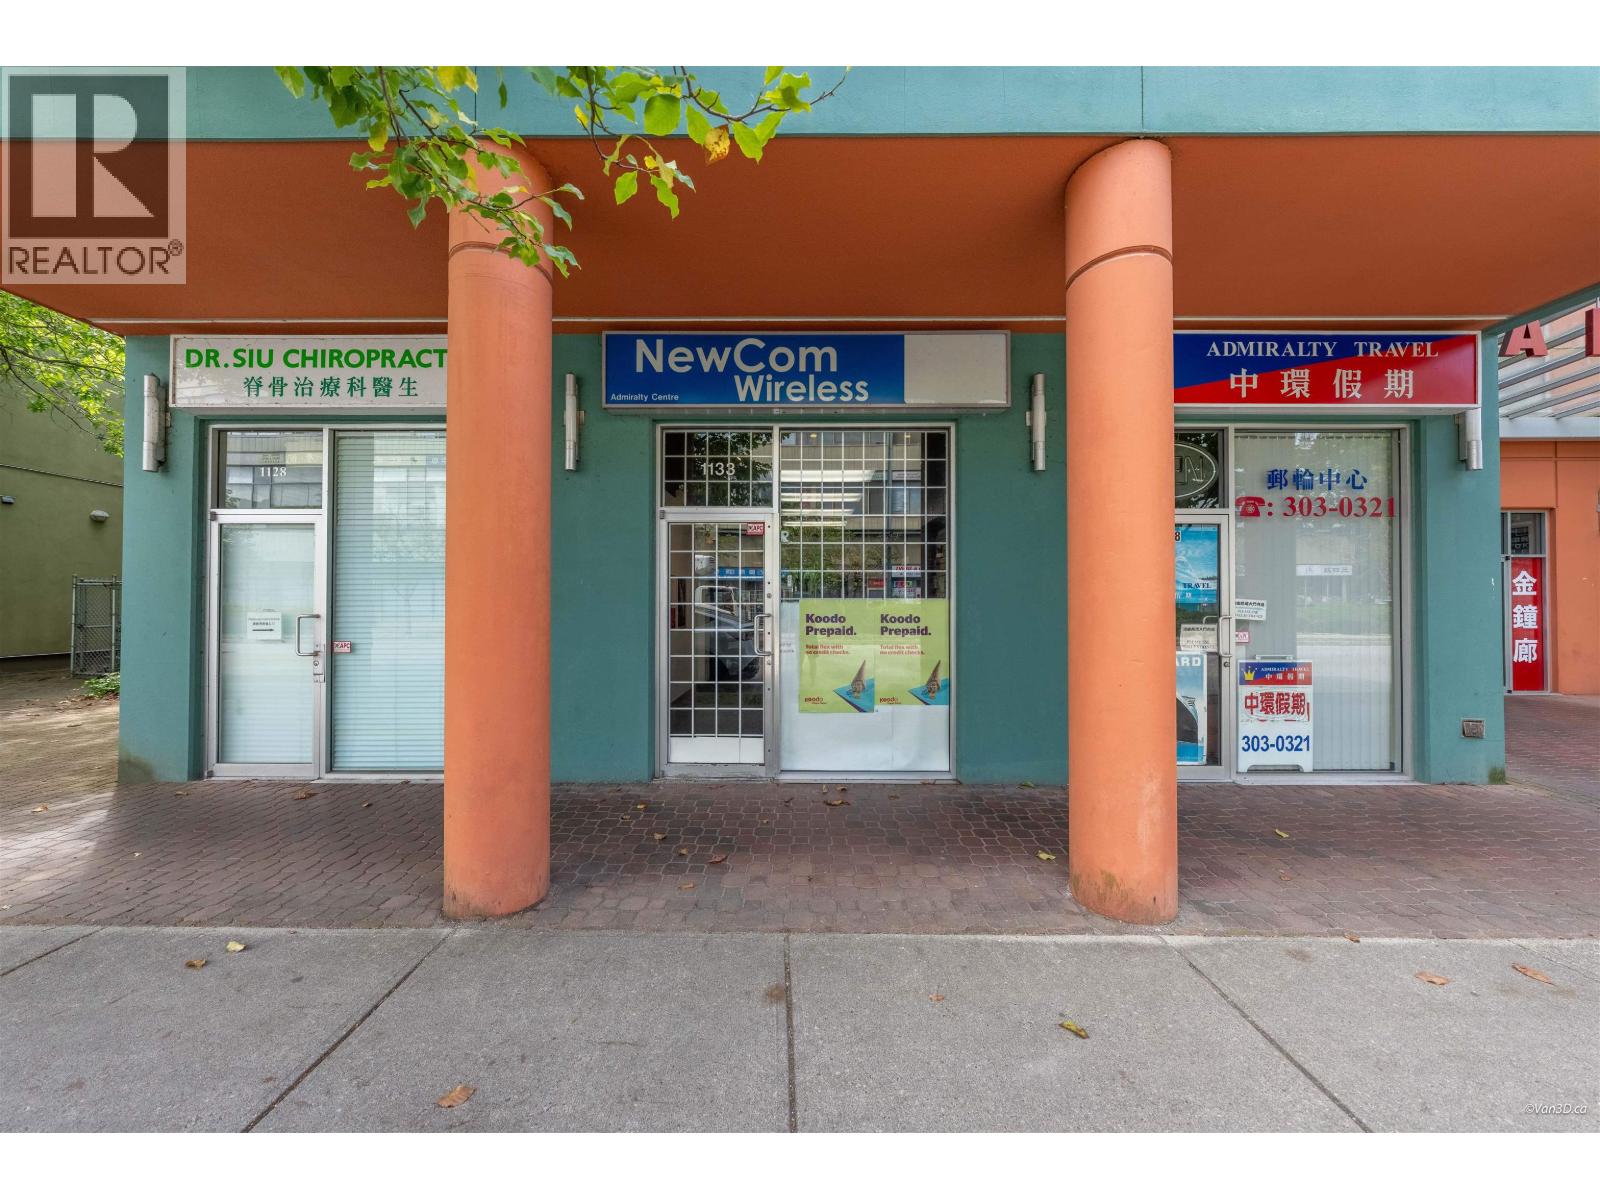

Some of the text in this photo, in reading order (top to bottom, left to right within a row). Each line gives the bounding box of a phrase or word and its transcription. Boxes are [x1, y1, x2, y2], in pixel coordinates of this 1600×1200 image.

[635, 338, 837, 373] NewCom
[1206, 341, 1439, 358] ADMIRALTY TRAVEL
[243, 376, 419, 398] 脊骨治療科醫生
[734, 374, 869, 403] Wireless
[1230, 368, 1415, 399] 中環假期
[610, 393, 679, 403] Admiralty Centre
[261, 466, 287, 477] 1128
[1266, 469, 1368, 491] 郵輪中心
[1282, 496, 1396, 518] 303-0321
[805, 613, 846, 624] Koodo
[880, 613, 920, 624] Koodo
[1512, 570, 1538, 664] 金鐘廊
[805, 625, 857, 637] Prepaid.
[880, 625, 932, 637] Prepaid.
[1244, 692, 1305, 715] 中環假期
[1241, 735, 1310, 752] 303-0321
